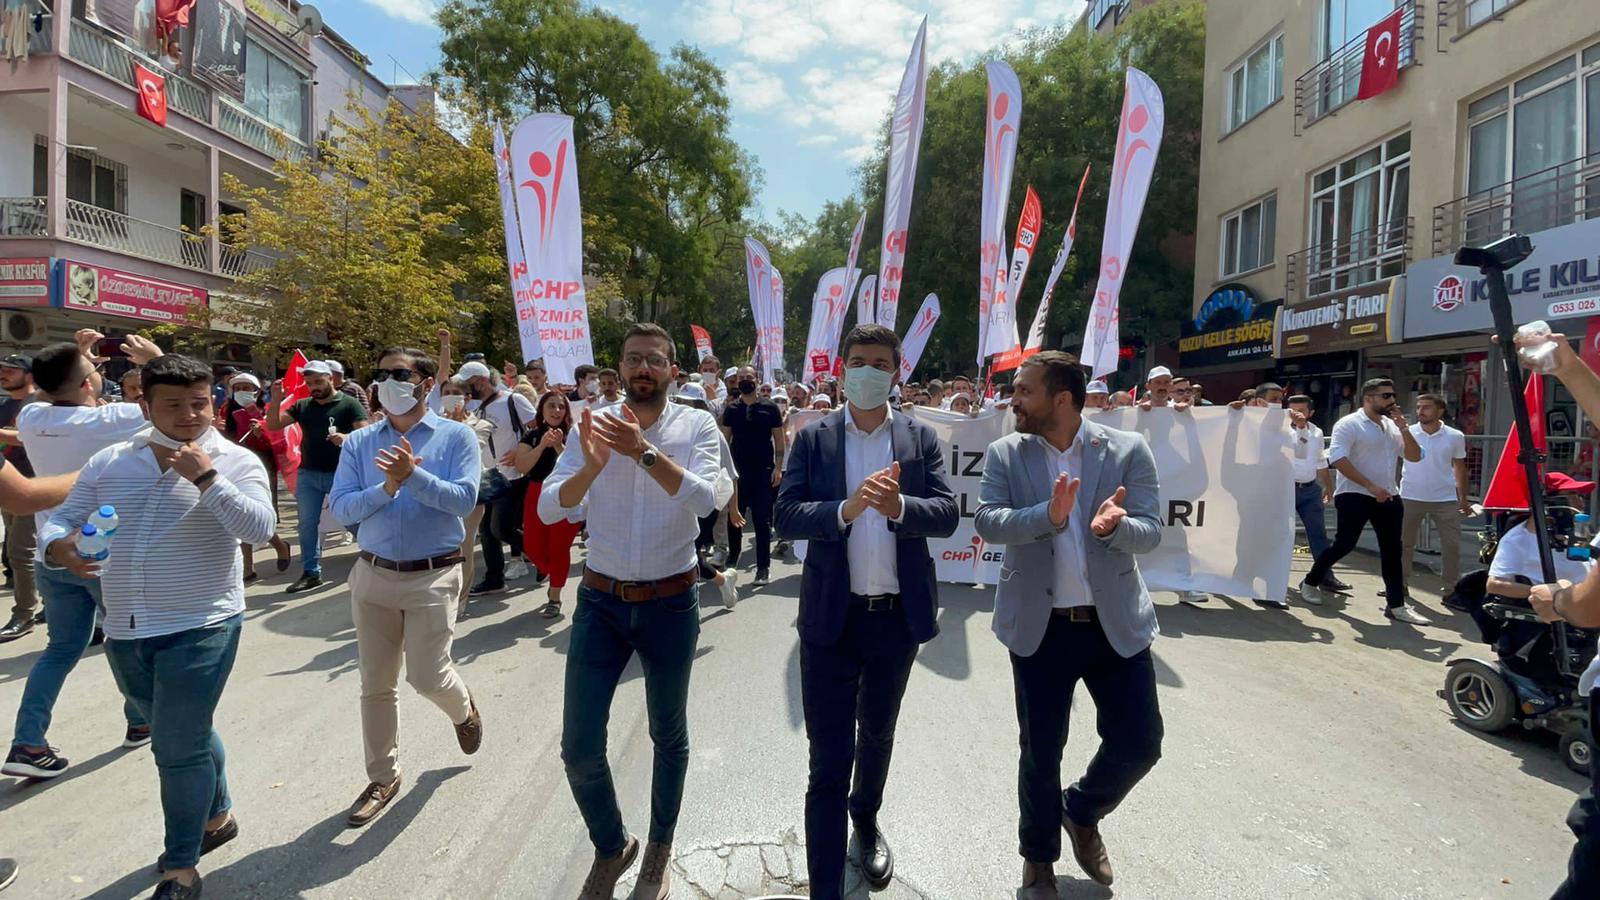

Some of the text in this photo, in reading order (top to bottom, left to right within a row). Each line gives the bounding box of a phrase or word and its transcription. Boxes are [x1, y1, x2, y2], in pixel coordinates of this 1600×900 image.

[532, 279, 580, 301] CHP
[1471, 268, 1540, 302] KLE
[1282, 293, 1387, 329] KURUYEMİŞ FUARI
[1552, 300, 1596, 313] 0533 026
[536, 308, 584, 323] ZMİR
[1203, 328, 1233, 348] KELLE
[1227, 347, 1251, 357] ANKARA
[942, 550, 973, 561] CHP
